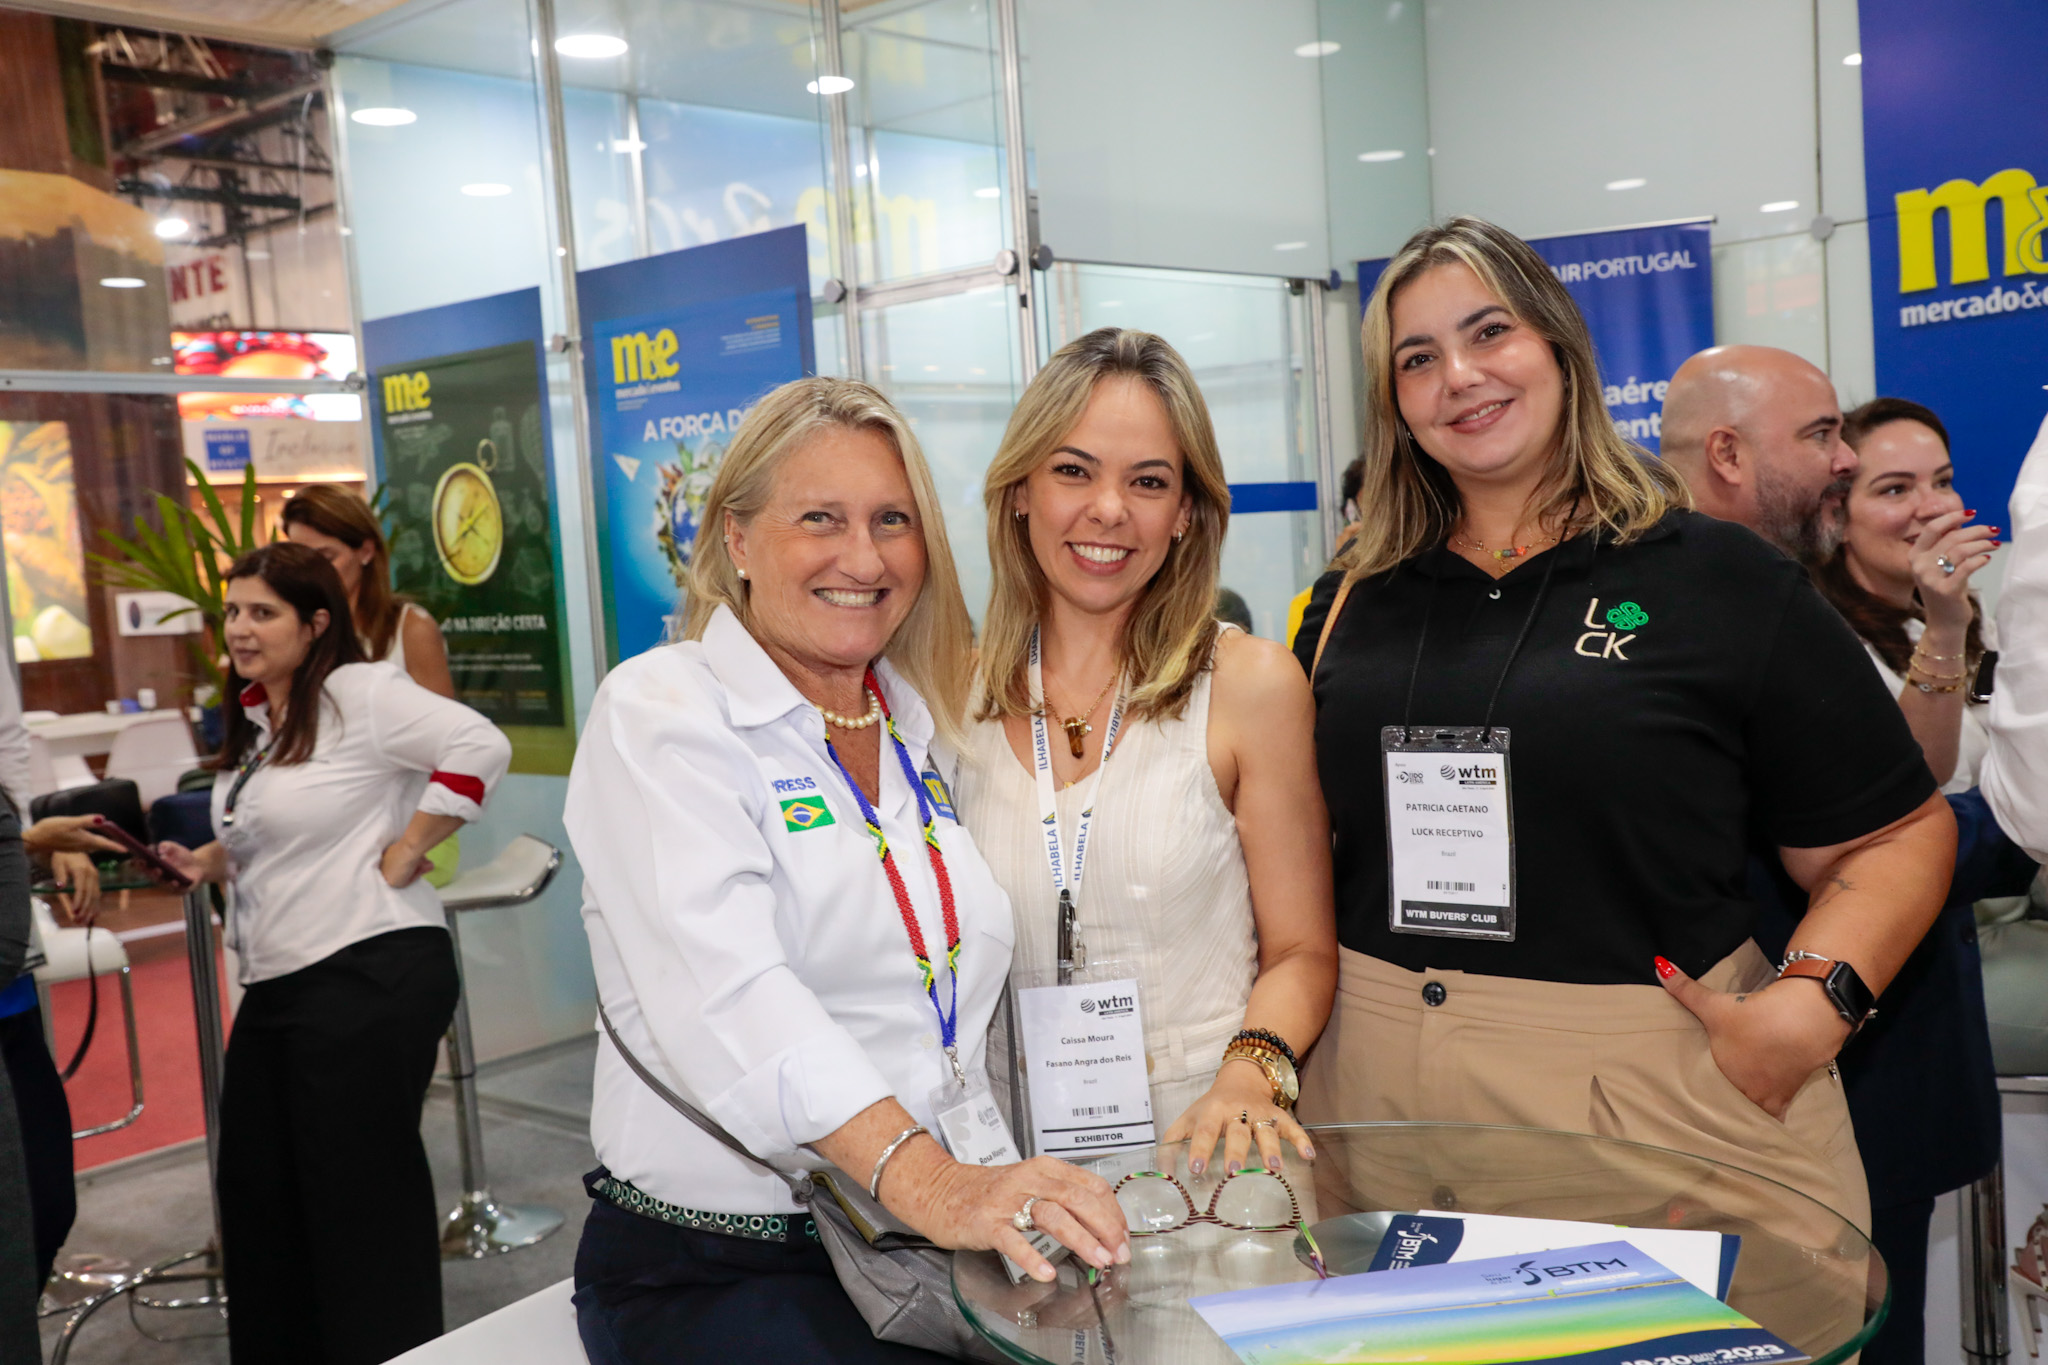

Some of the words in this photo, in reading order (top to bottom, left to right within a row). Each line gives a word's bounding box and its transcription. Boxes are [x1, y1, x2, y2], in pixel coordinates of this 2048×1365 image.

[1582, 250, 1698, 281] PORTUGAL
[1899, 281, 2048, 328] mercado&
[643, 420, 660, 442] A
[1035, 717, 1049, 770] ILHABELA
[1458, 765, 1496, 779] wtm
[771, 776, 816, 794] RESS
[1406, 803, 1445, 813] PATRICIA
[1446, 804, 1489, 814] CAETANO
[1411, 828, 1434, 837] LUCK
[1435, 828, 1484, 838] RECEPTIVO
[1045, 828, 1063, 888] ILHABELA
[1074, 822, 1089, 882] ILHABELA
[1405, 909, 1428, 920] WTM
[1471, 913, 1498, 924] CLUB
[1097, 995, 1133, 1010] wtm
[1061, 1037, 1086, 1045] Caissa
[1088, 1034, 1115, 1044] Moura
[1046, 1060, 1073, 1068] Fasano
[1074, 1058, 1098, 1069] Angra
[1099, 1056, 1114, 1065] dos
[1115, 1054, 1132, 1063] Reis
[1074, 1132, 1124, 1143] EXHIBITOR
[1542, 1257, 1628, 1278] BTM
[1716, 1344, 1785, 1360] 2023
